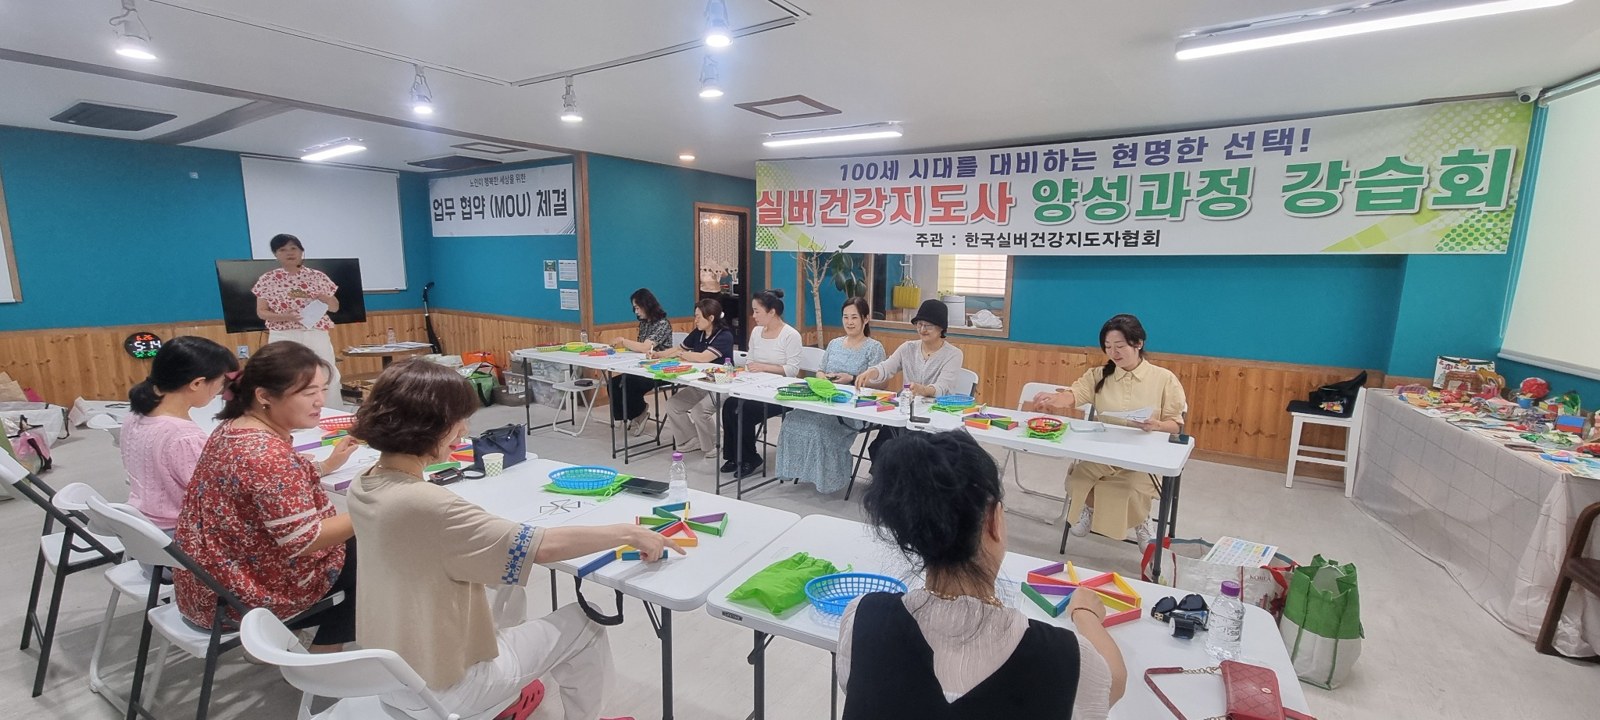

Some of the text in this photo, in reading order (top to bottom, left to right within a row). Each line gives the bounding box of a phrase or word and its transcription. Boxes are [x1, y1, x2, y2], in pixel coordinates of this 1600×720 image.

[838, 127, 1312, 182] 100세 시대를 대비하는 현명한 선택!
[515, 172, 526, 184] 위한
[756, 147, 1517, 226] 실버건강지도사 양성과정 강습회
[432, 188, 568, 222] 업무 협약 (MOU) 체결
[915, 232, 944, 249] 주관
[964, 230, 1161, 249] 한국실버건강지도자협회
[133, 340, 162, 351] 5:14
